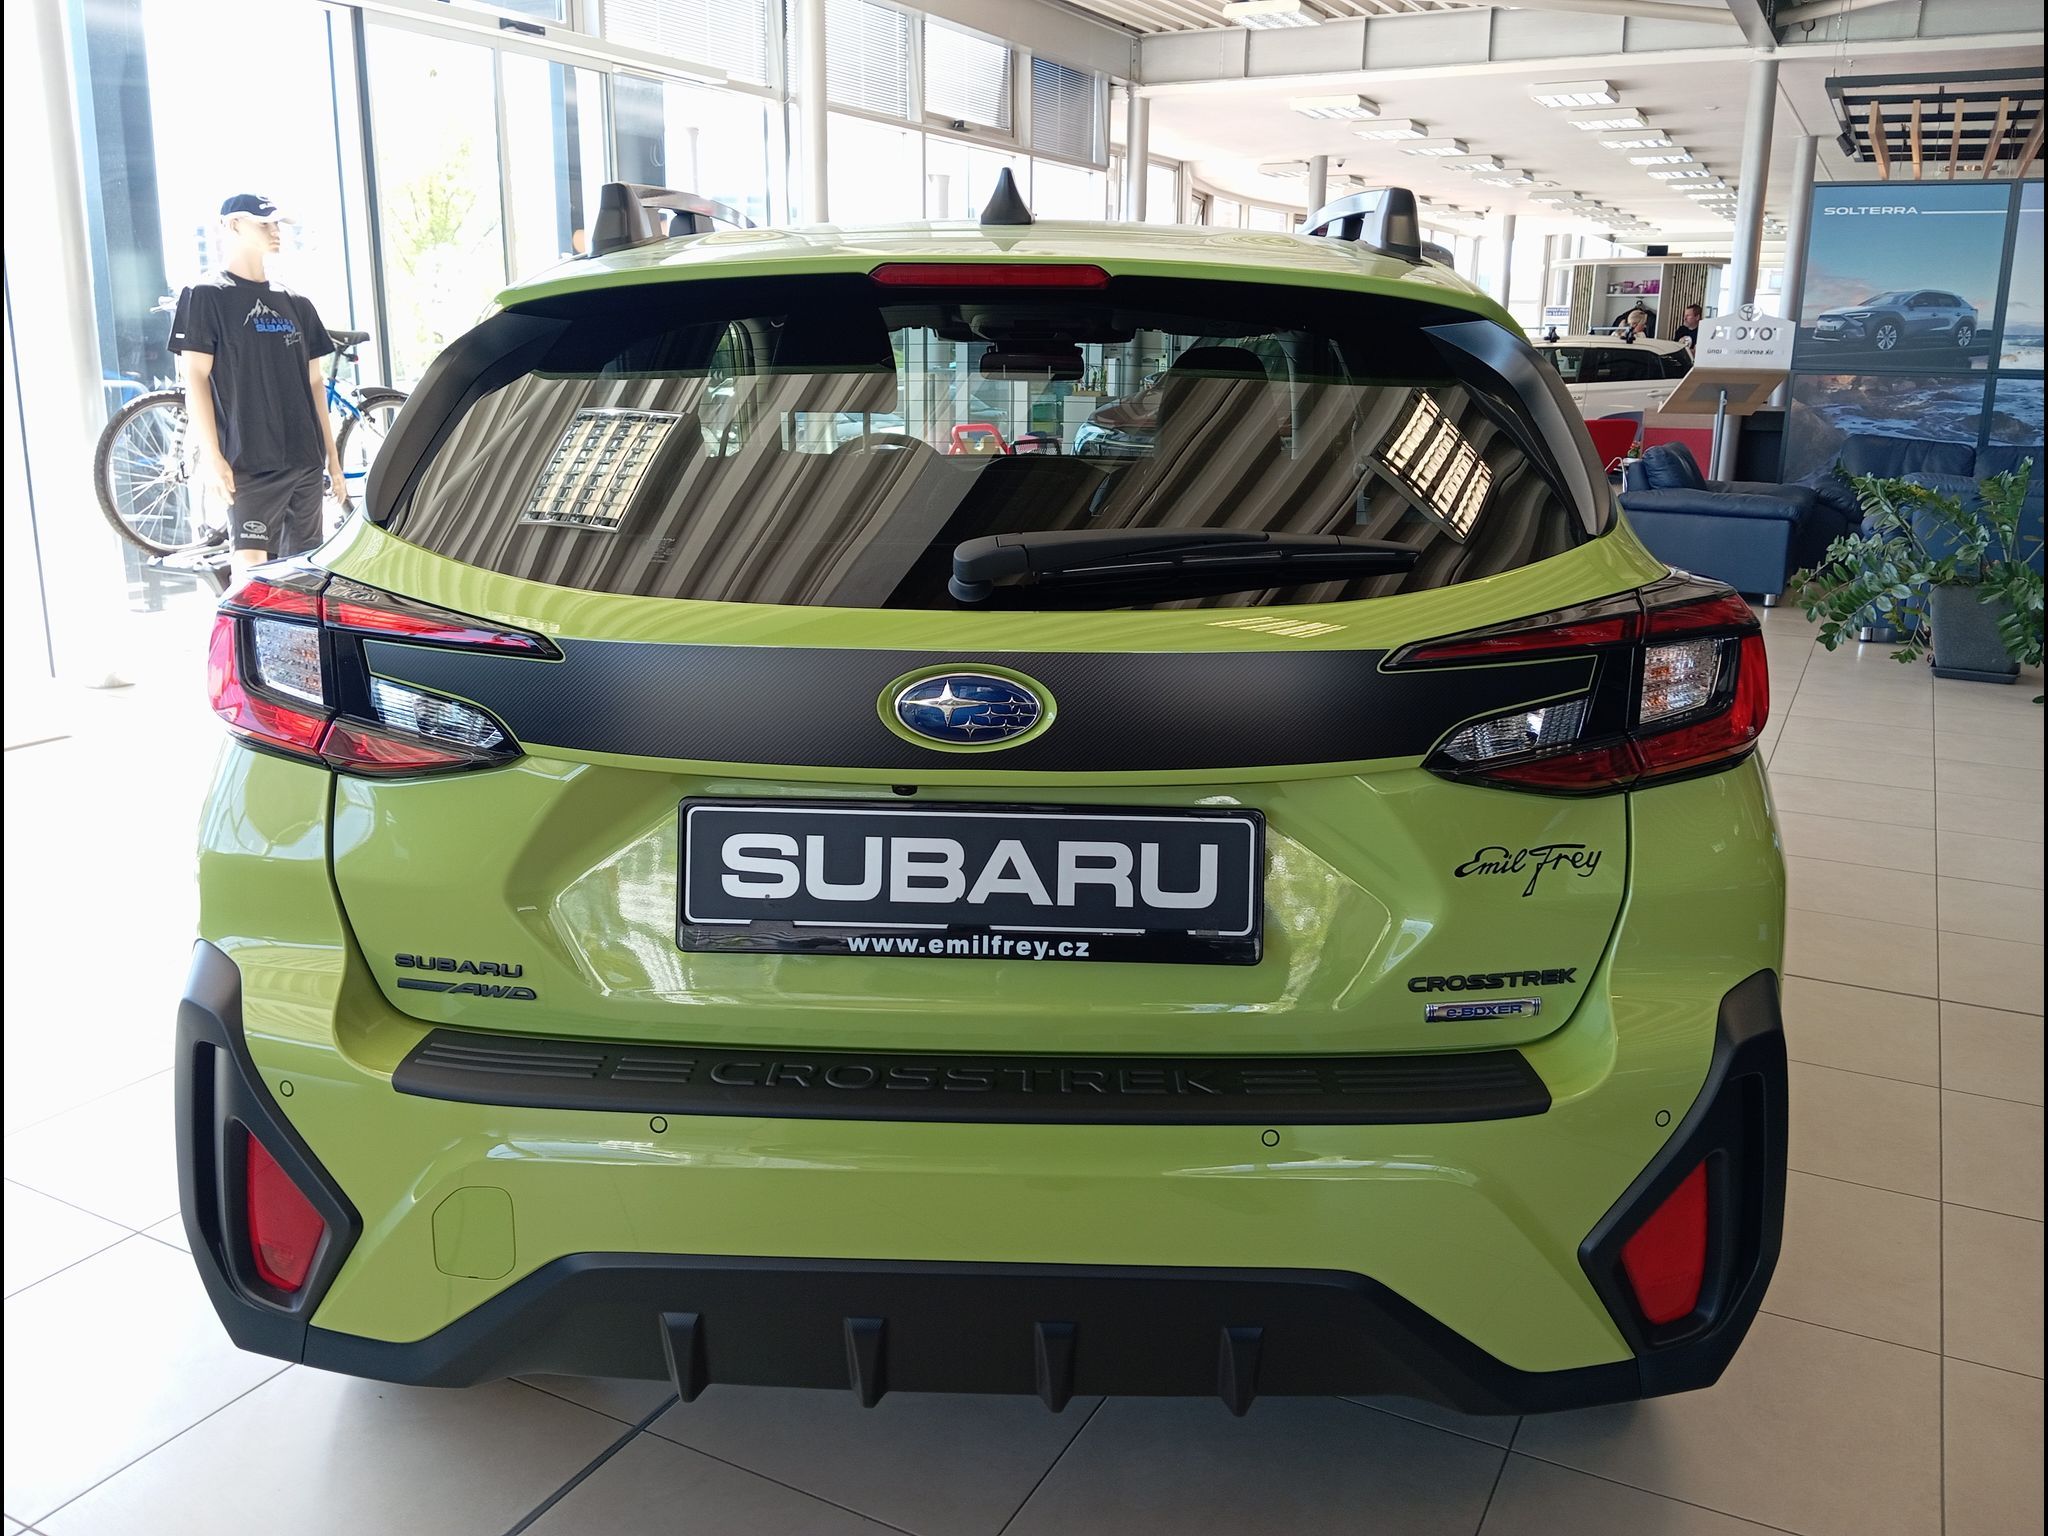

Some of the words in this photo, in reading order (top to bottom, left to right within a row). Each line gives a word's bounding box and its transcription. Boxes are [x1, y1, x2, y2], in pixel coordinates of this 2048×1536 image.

[1823, 206, 1919, 216] SOLTERRA
[720, 833, 1218, 910] SUBARU
[1454, 845, 1528, 878] Emil
[1521, 843, 1602, 898] Frey
[847, 935, 1090, 961] www.emilfrey.cz
[394, 953, 523, 978] SUBARU
[447, 982, 538, 1001] AWD
[1407, 967, 1578, 993] CROSSTREK
[1446, 1004, 1523, 1018] e-BOXER
[710, 1061, 1224, 1095] CROSSTREK
